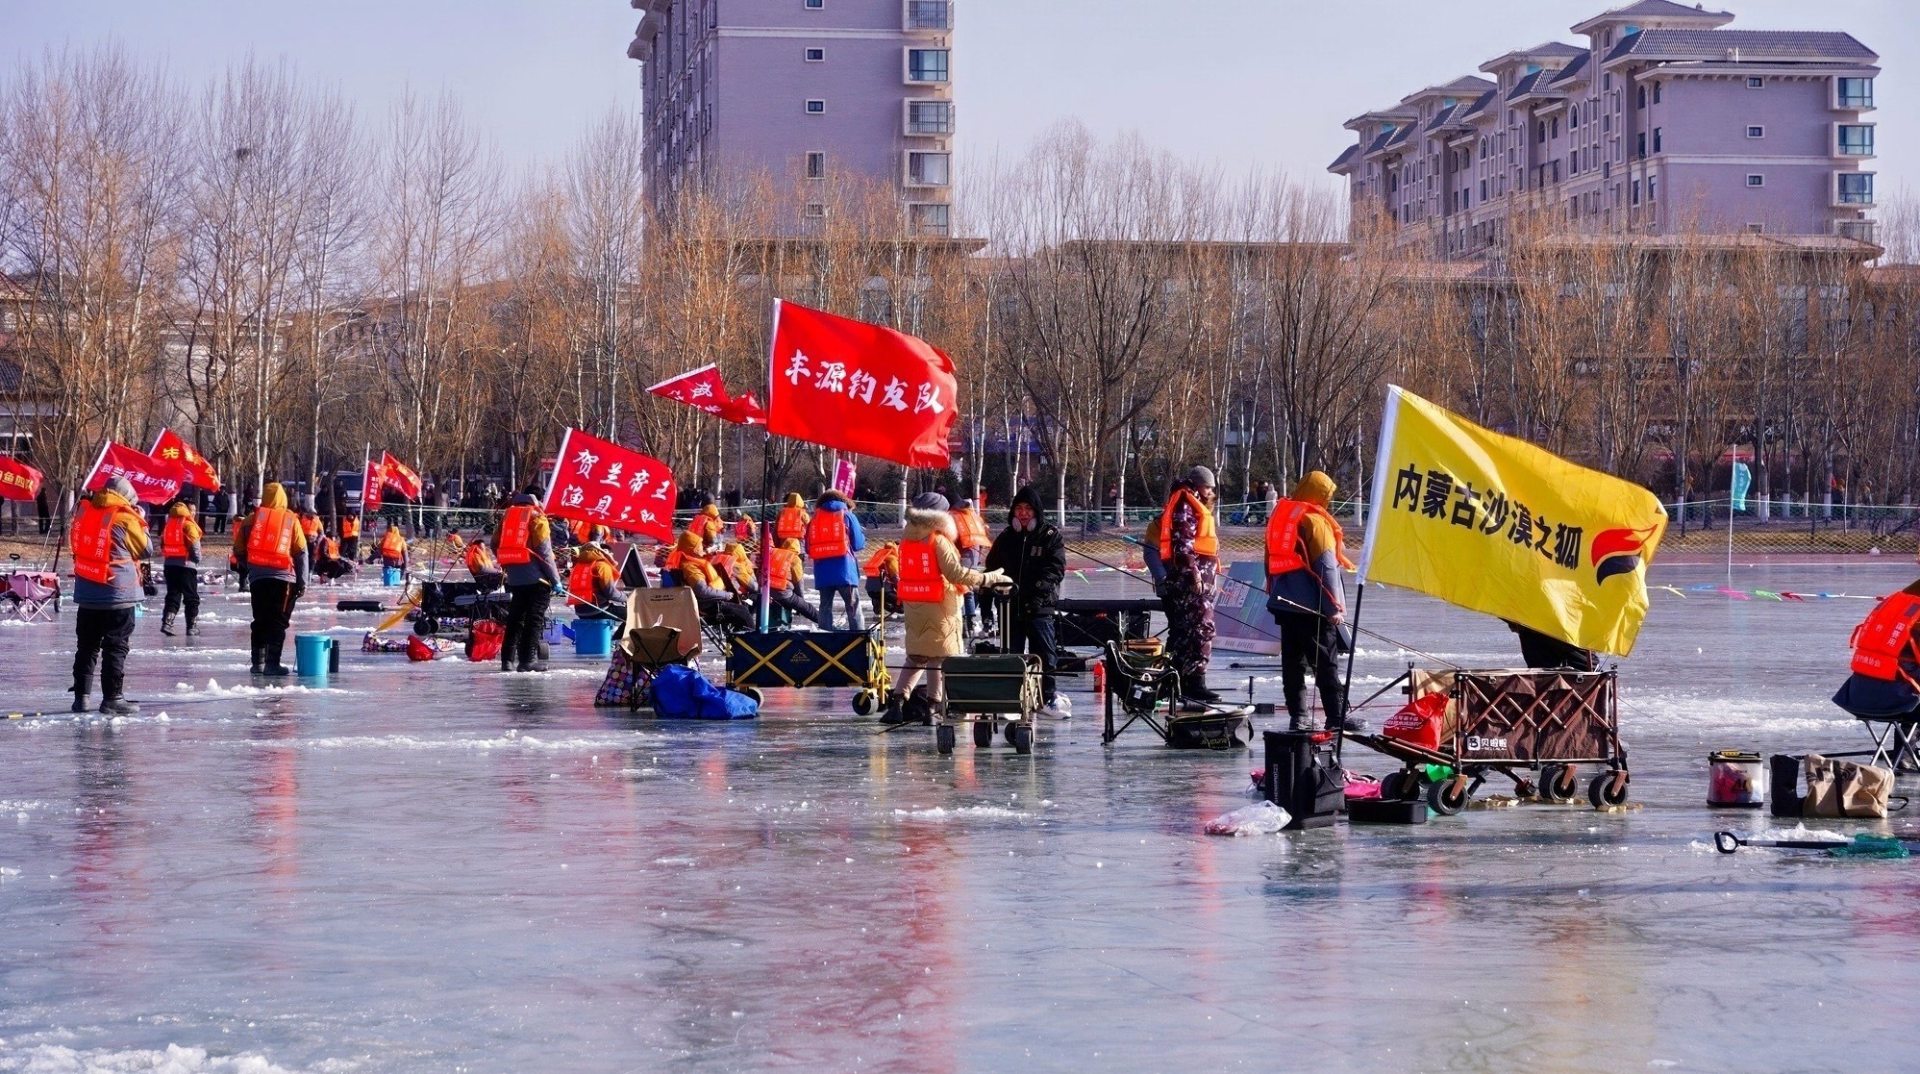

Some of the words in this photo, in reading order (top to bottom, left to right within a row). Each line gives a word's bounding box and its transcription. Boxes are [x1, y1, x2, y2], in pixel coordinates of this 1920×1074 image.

[785, 349, 944, 414] 丰源钓友队
[1392, 463, 1583, 570] 内蒙古沙漠之狐
